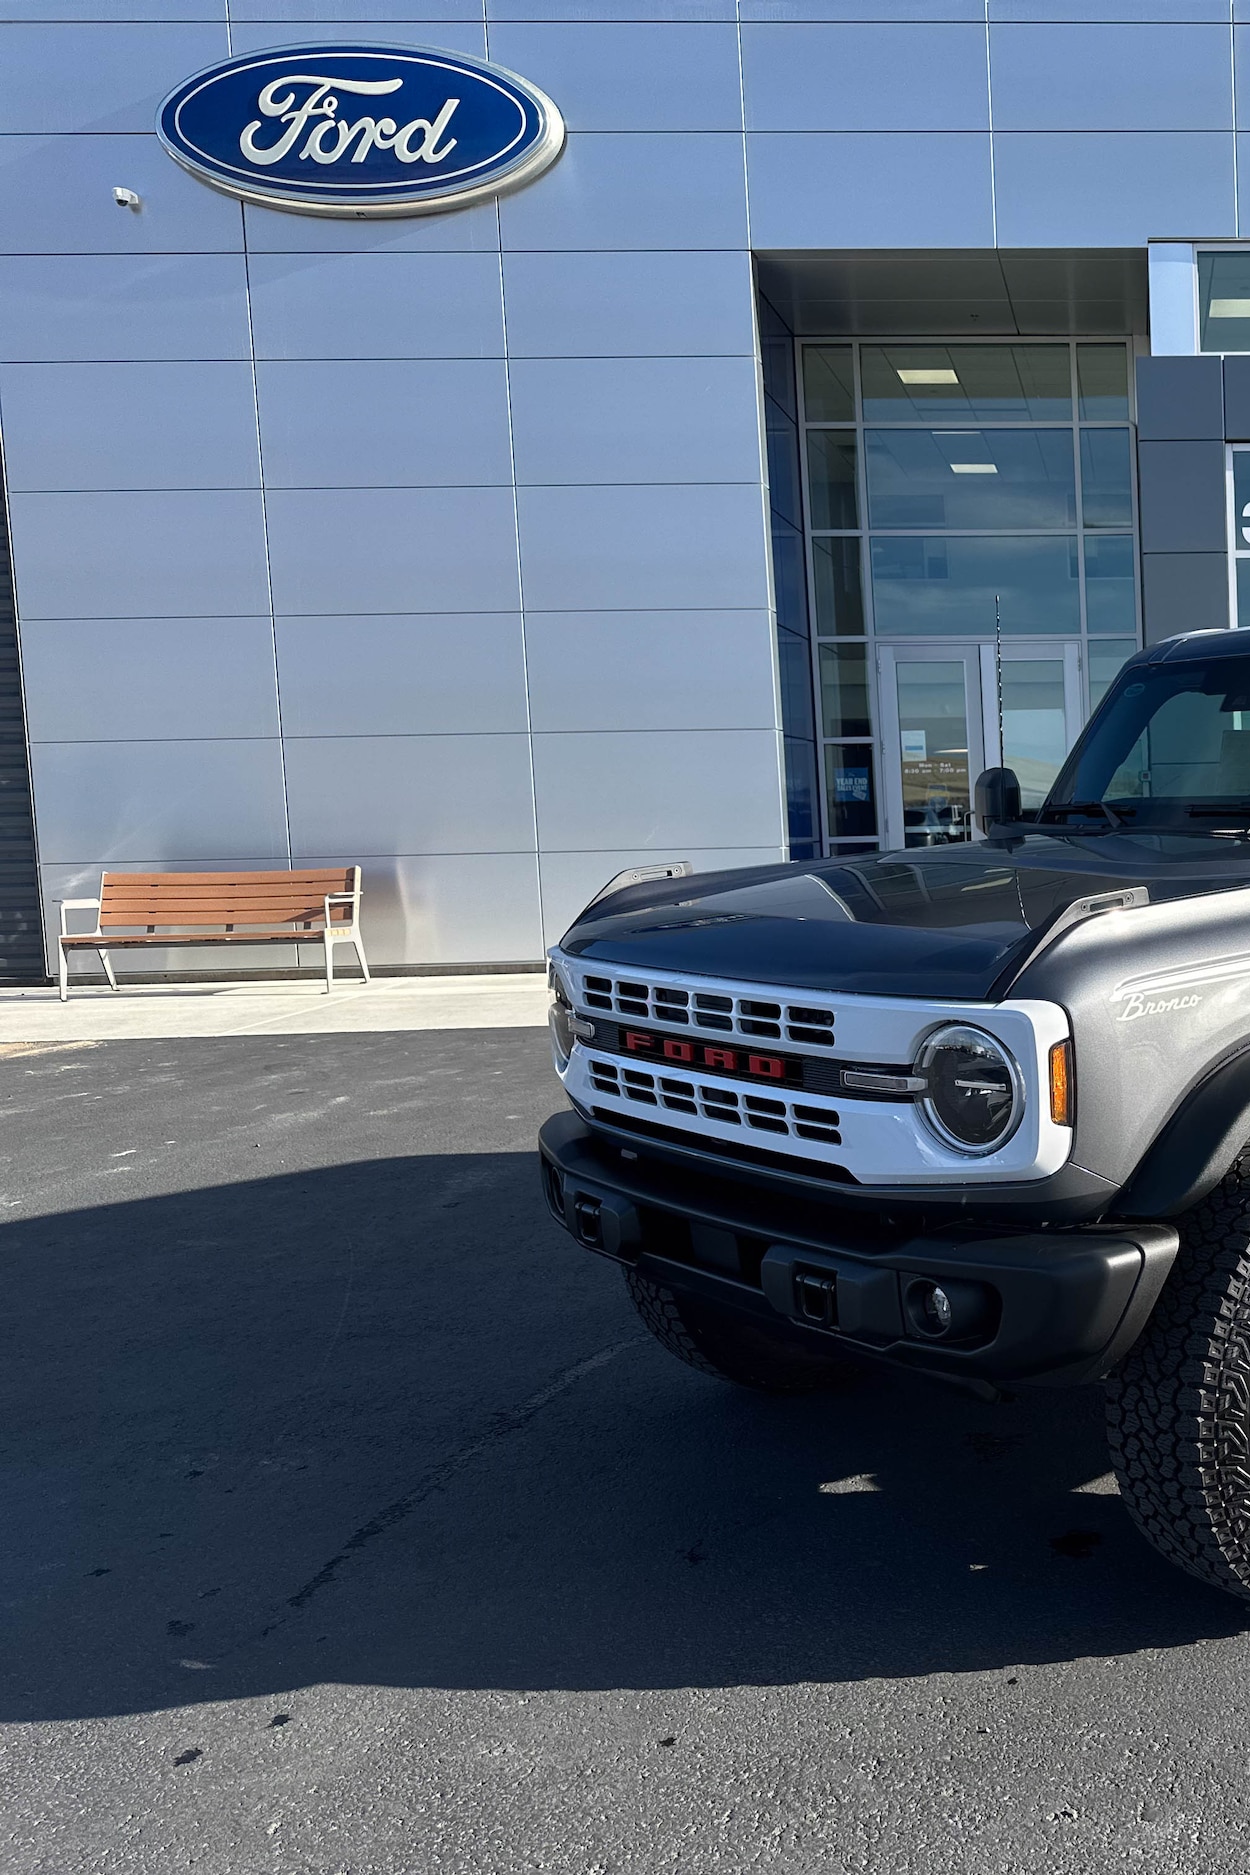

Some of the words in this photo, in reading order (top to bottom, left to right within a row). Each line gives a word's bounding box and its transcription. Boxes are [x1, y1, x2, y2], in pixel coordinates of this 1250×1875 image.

[239, 75, 460, 165] Ford
[836, 777, 853, 785] YEAR
[854, 777, 868, 785] END
[1116, 992, 1203, 1021] Bronco
[626, 1031, 785, 1078] FORD
